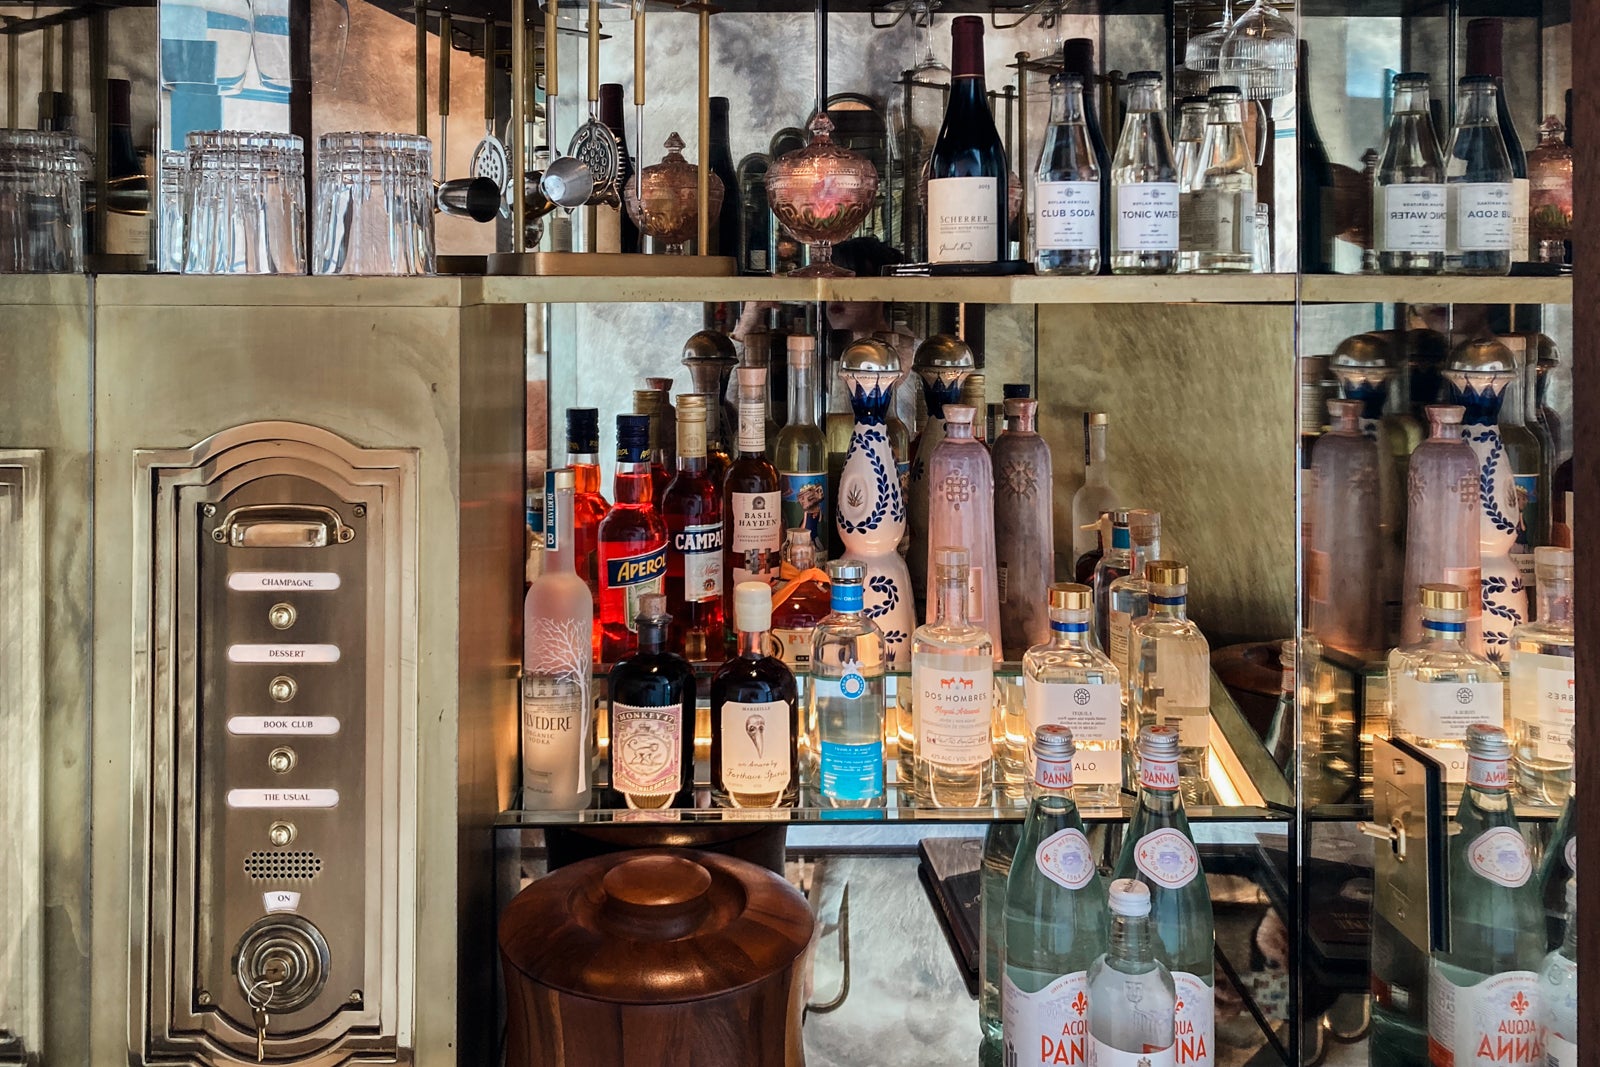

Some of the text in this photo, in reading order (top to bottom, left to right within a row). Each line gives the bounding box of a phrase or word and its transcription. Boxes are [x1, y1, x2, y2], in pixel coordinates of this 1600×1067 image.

[1041, 209, 1096, 218] CLUB SODA
[1122, 210, 1178, 218] TONIC WATE
[739, 518, 777, 527] HAYDEN
[675, 529, 724, 550] CAMPA
[617, 552, 666, 583] APEROL
[262, 578, 314, 587] CHAMPAGNE
[924, 690, 986, 702] DOS HOMBRES
[619, 712, 662, 720] MONKEY
[1144, 768, 1176, 784] PANNA
[1041, 1034, 1084, 1065] PAN
